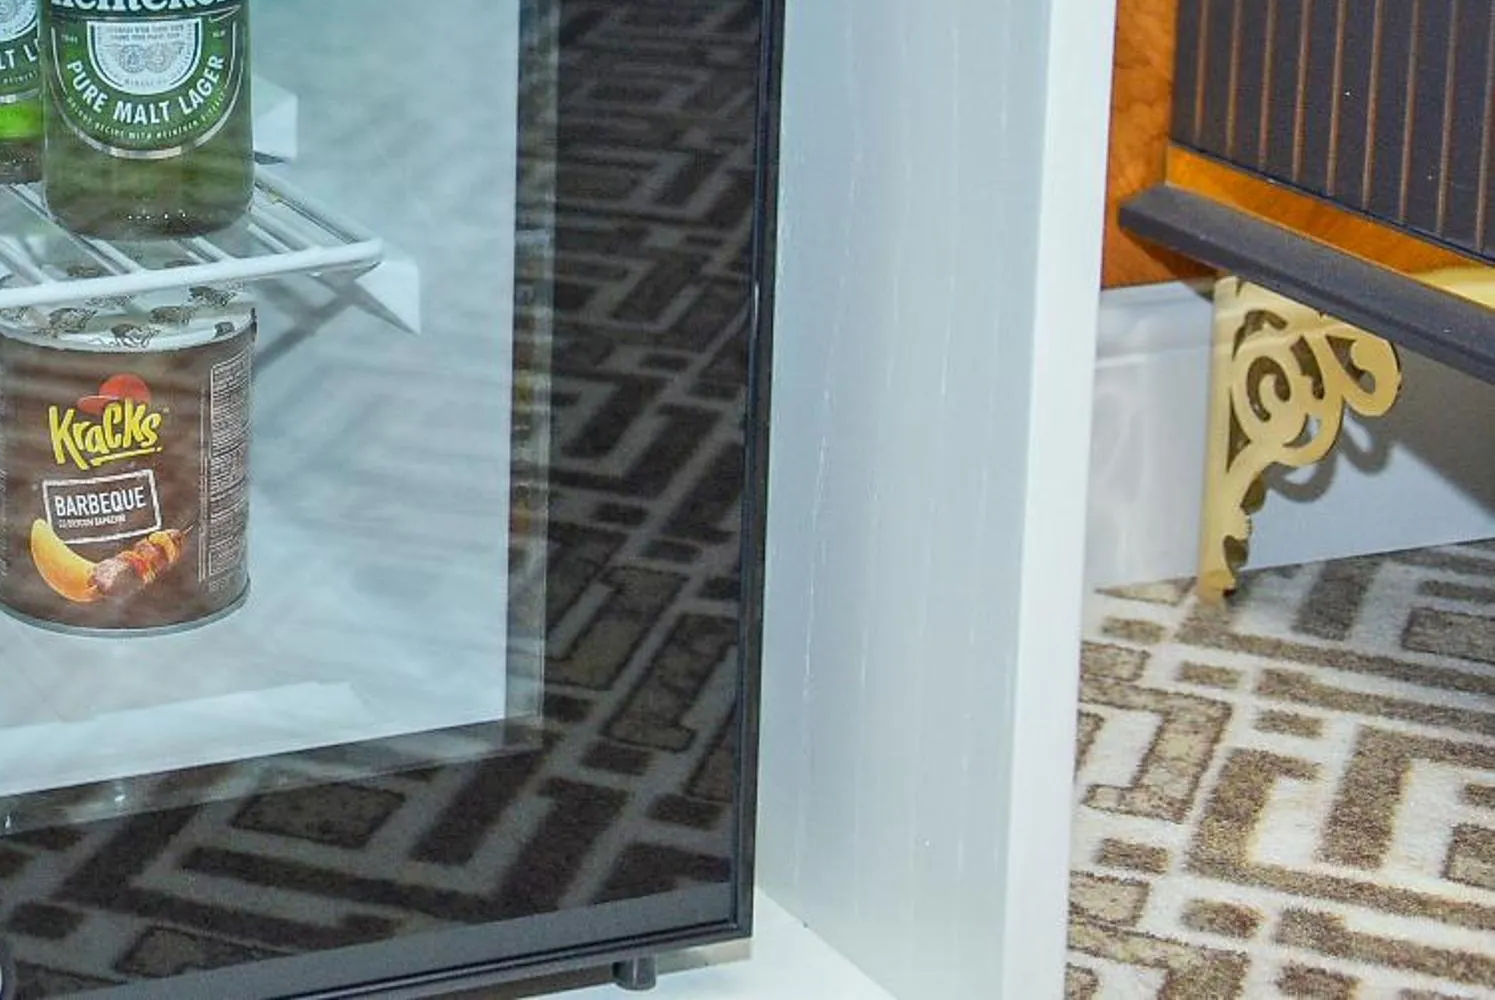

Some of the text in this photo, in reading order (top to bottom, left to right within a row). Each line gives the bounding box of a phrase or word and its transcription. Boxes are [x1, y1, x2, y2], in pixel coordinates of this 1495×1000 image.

[67, 60, 108, 113] PURE
[113, 100, 170, 125] MALT
[178, 55, 224, 115] LAGER
[54, 486, 146, 517] BARBEQUE
